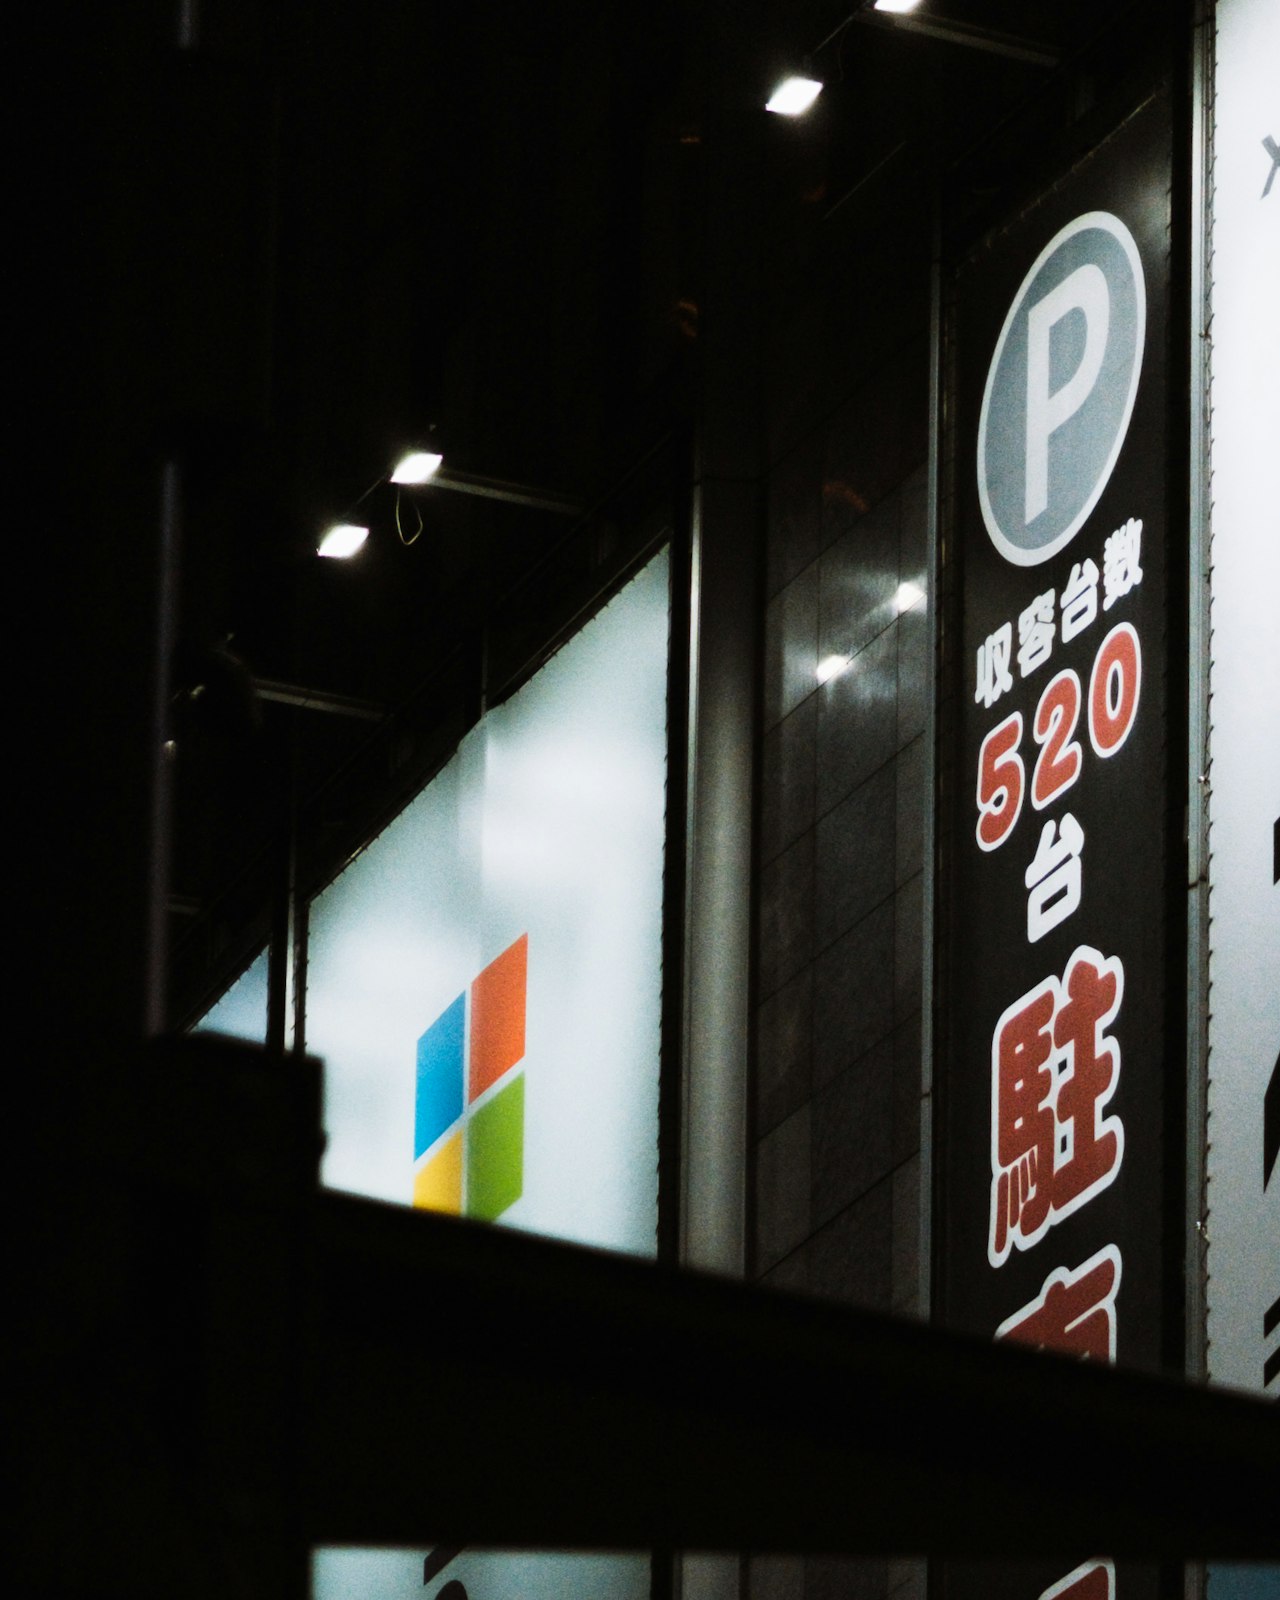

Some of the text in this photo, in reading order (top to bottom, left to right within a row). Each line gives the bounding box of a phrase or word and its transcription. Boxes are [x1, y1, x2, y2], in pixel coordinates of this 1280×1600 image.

[1023, 263, 1111, 527] P
[975, 517, 1144, 709] 収容台数
[975, 620, 1143, 853] 520
[1025, 812, 1086, 944] 台
